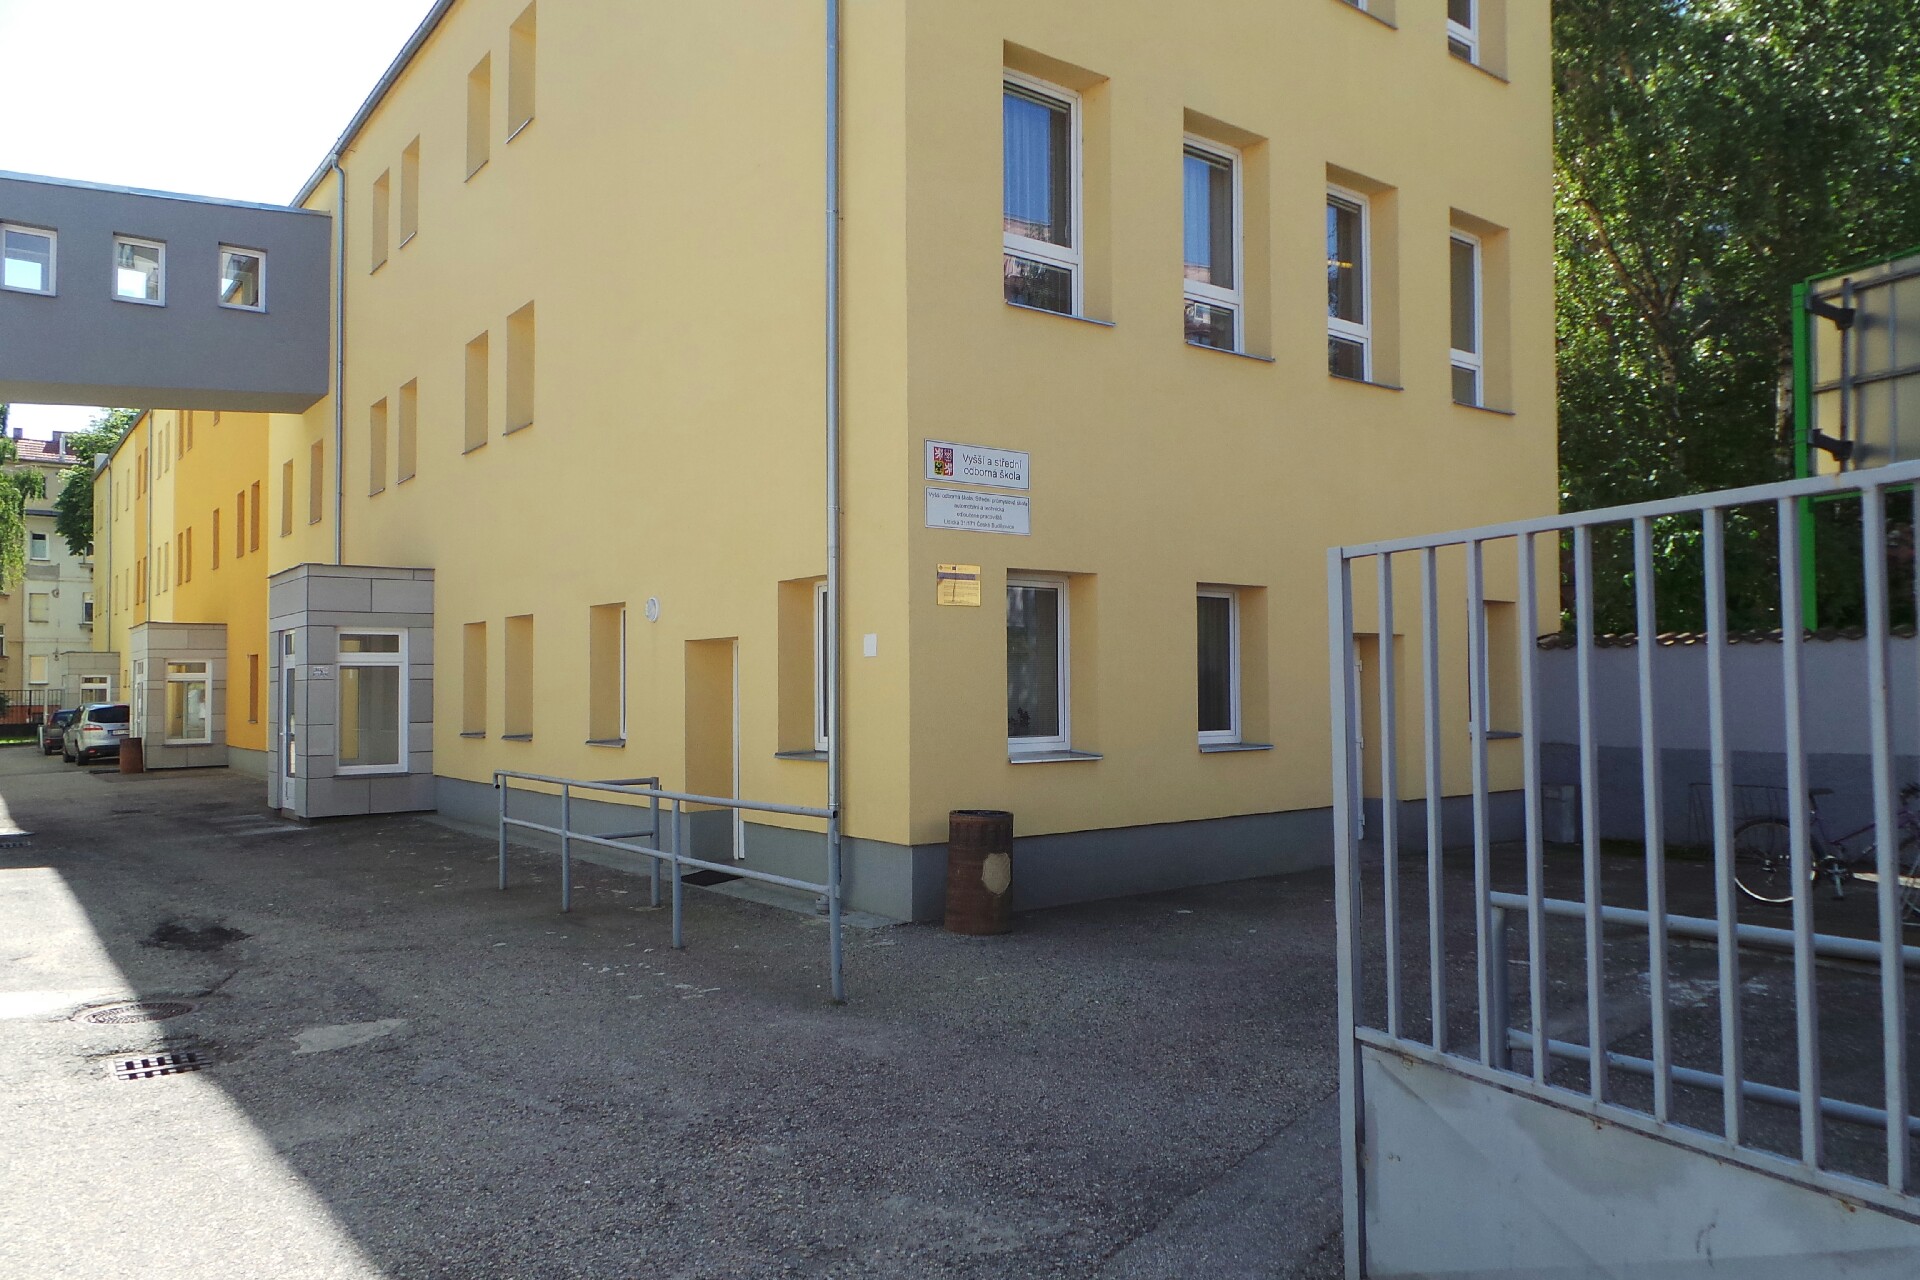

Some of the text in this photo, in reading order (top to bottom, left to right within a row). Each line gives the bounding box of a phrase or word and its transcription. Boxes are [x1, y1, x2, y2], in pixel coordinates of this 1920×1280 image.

[962, 453, 1022, 469] Vyšší a střední
[963, 466, 1021, 480] odborná škola
